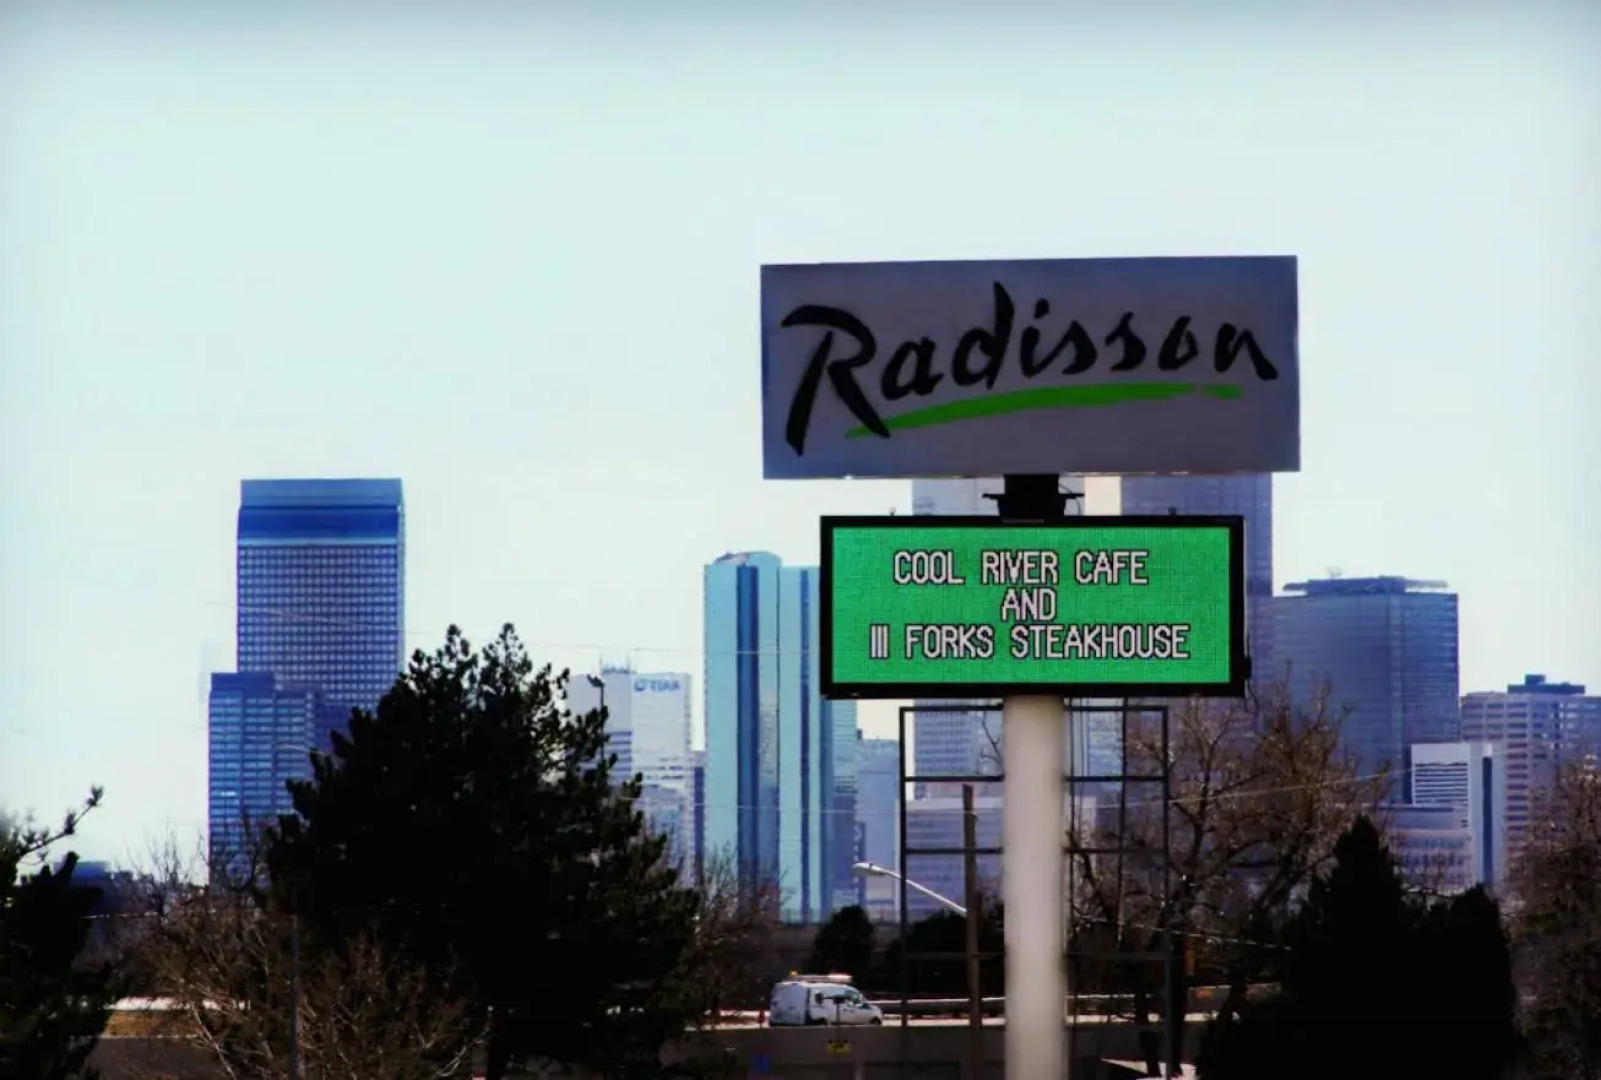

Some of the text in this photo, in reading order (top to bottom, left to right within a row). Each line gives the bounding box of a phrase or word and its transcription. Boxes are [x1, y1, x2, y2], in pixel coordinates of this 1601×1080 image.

[781, 281, 1278, 457] Radisson
[894, 550, 1149, 585] COOL RIVER CAFE
[1001, 587, 1056, 622] AND
[905, 624, 994, 659] FORKS
[1010, 624, 1190, 660] STEAKHOUSE
